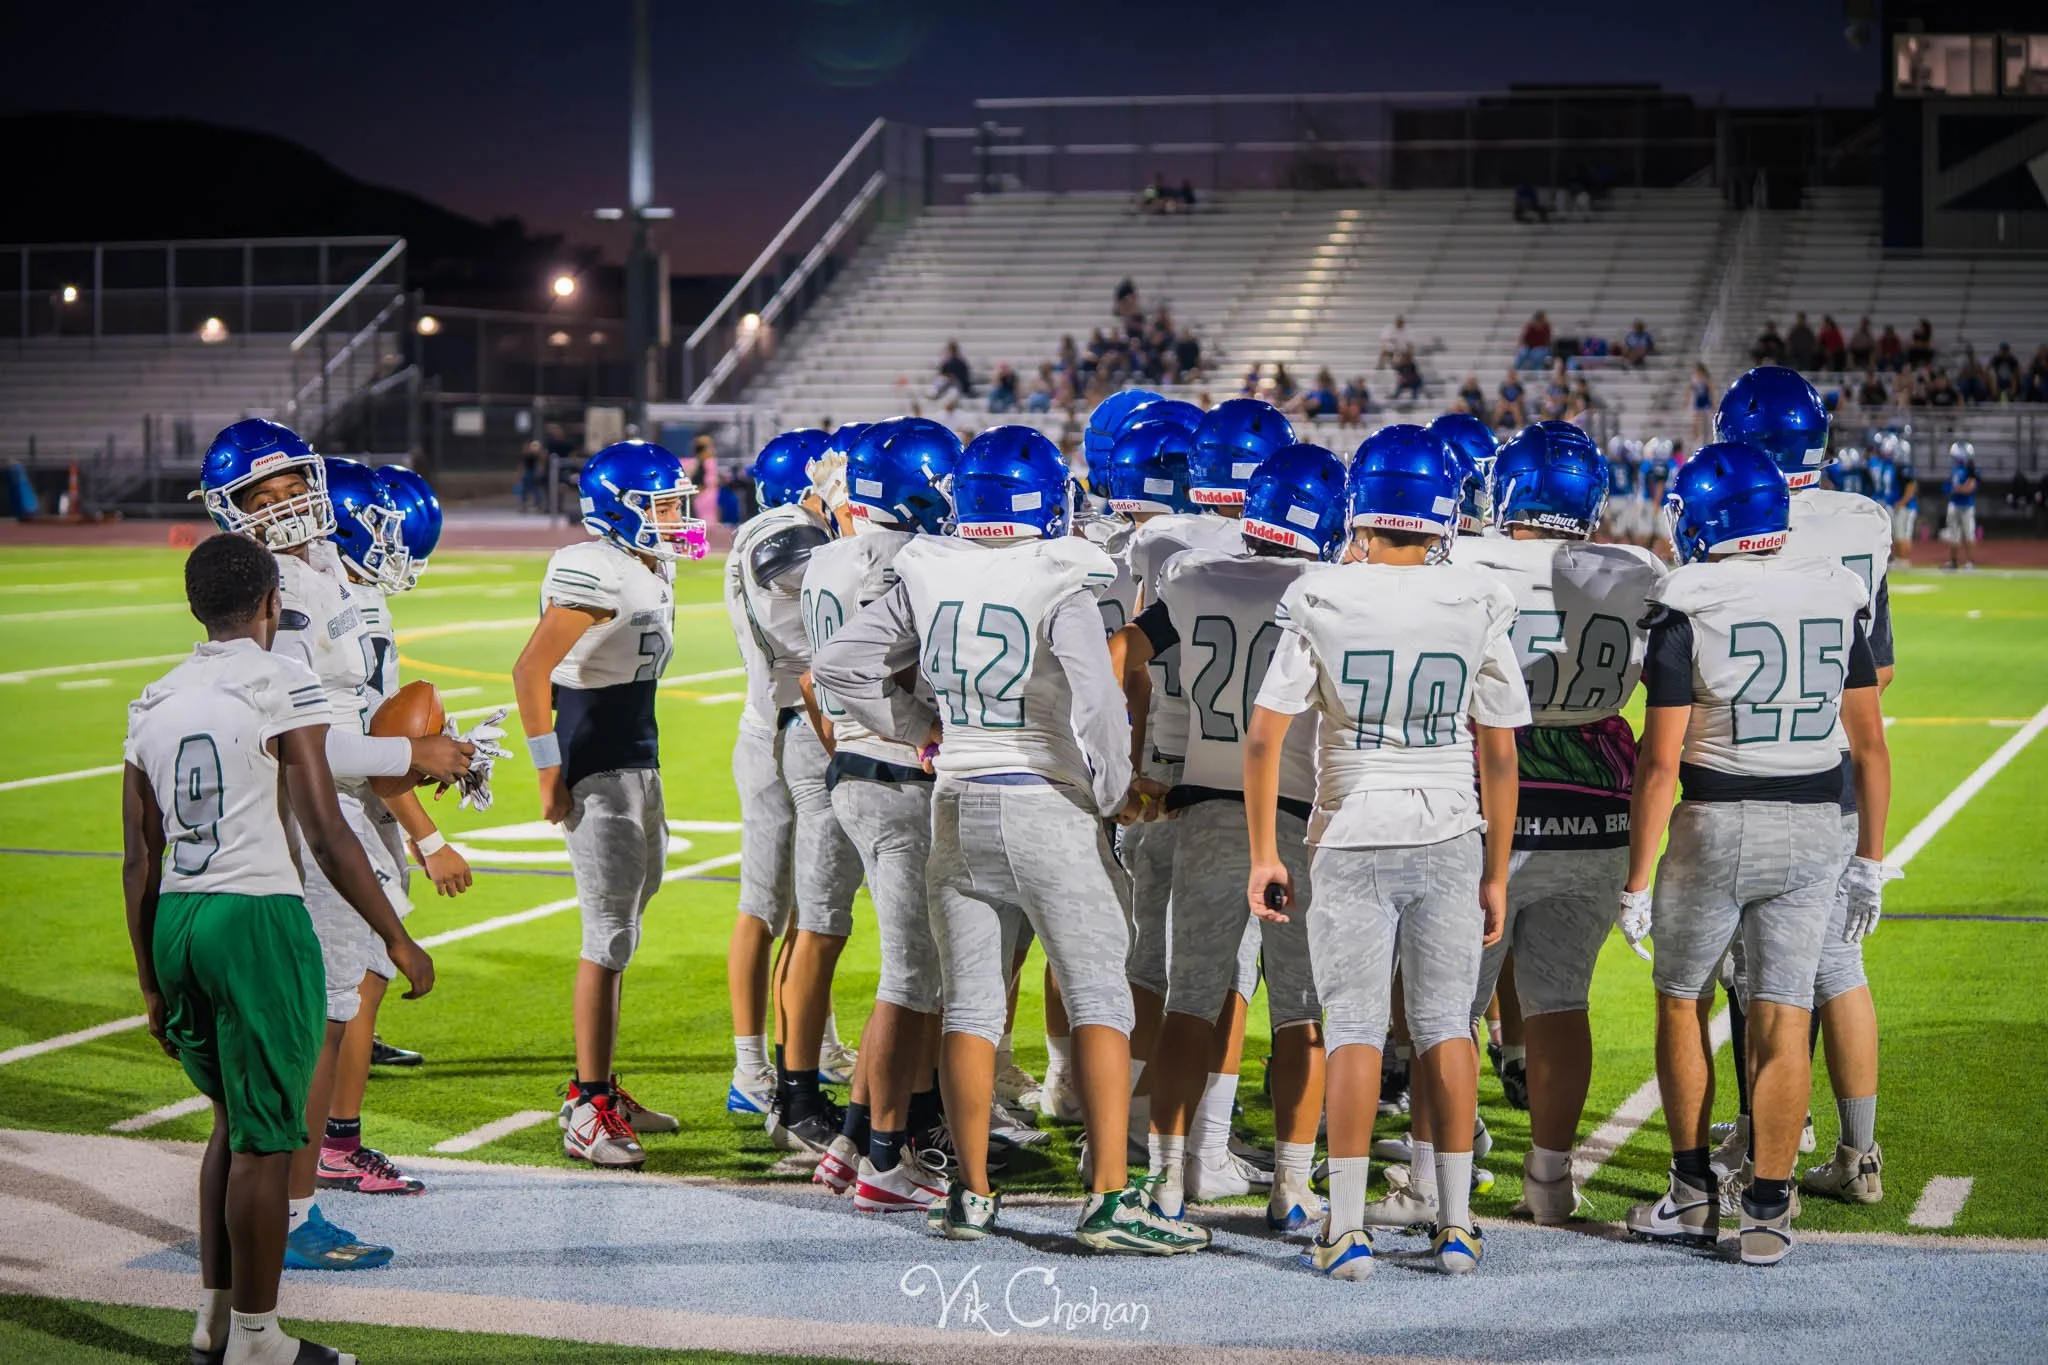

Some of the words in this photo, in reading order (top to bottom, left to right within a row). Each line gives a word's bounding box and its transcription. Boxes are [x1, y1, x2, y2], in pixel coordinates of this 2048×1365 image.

[1194, 490, 1243, 503] Riddell
[962, 525, 1014, 537] Riddell
[1374, 516, 1423, 529] Riddell
[1538, 513, 1579, 527] schutt
[1245, 519, 1295, 546] Riddell
[1739, 533, 1787, 550] Riddell
[923, 601, 1031, 727] 42
[1507, 610, 1631, 711] 58
[1729, 618, 1843, 745] 25
[1342, 650, 1467, 750] 70
[172, 733, 224, 876] 9
[1605, 813, 1631, 832] BR
